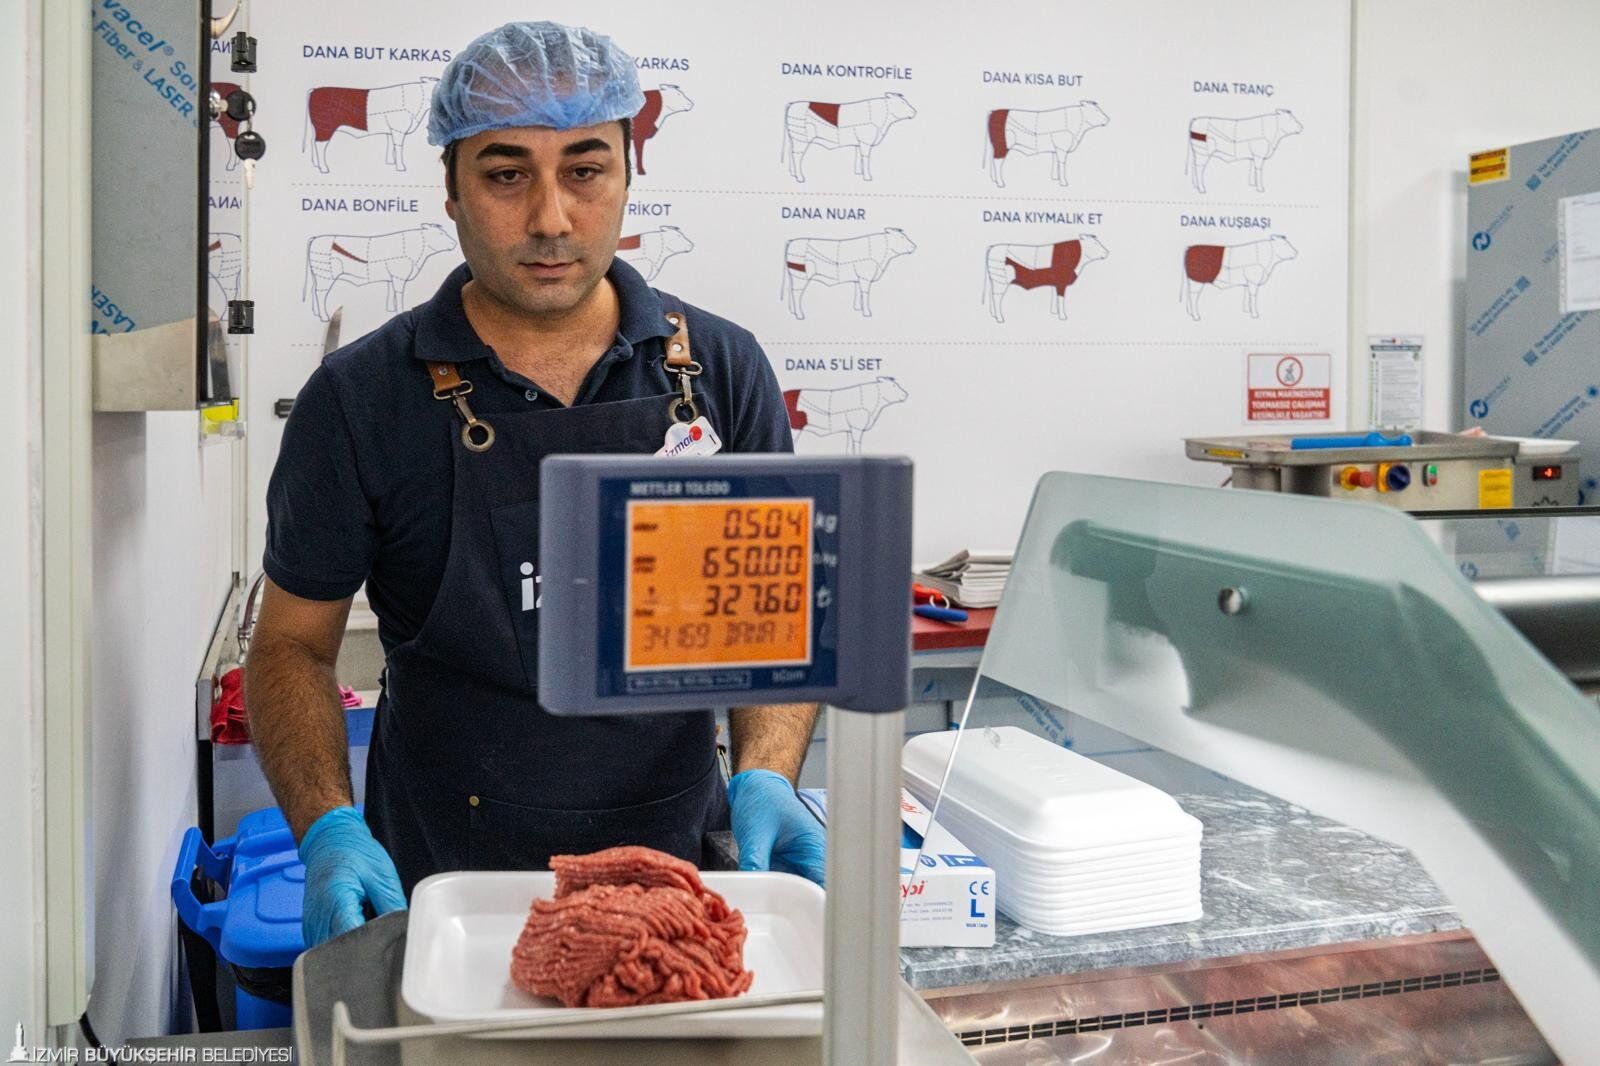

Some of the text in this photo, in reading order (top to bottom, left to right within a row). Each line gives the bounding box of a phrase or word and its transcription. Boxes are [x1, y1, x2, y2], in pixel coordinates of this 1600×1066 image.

[303, 45, 451, 62] DANA BUT KARKAS
[95, 20, 136, 60] Fiber
[143, 68, 193, 118] LASER
[781, 62, 912, 80] DANA KONTROFİLE
[983, 71, 1083, 87] DANA KISA BUT
[1193, 81, 1274, 98] DANA TRANÇ
[302, 196, 419, 212] DANA BONFİLE
[628, 201, 672, 216] RİKOT
[781, 207, 866, 221] DANA NUAR
[983, 210, 1103, 225] DANA KIYMALIK ET
[1180, 215, 1271, 229] DANA KUŞBAŞI
[785, 358, 826, 371] DANA
[857, 358, 882, 371] SET
[630, 480, 731, 496] METTLER TOLEDO
[970, 898, 985, 918] L
